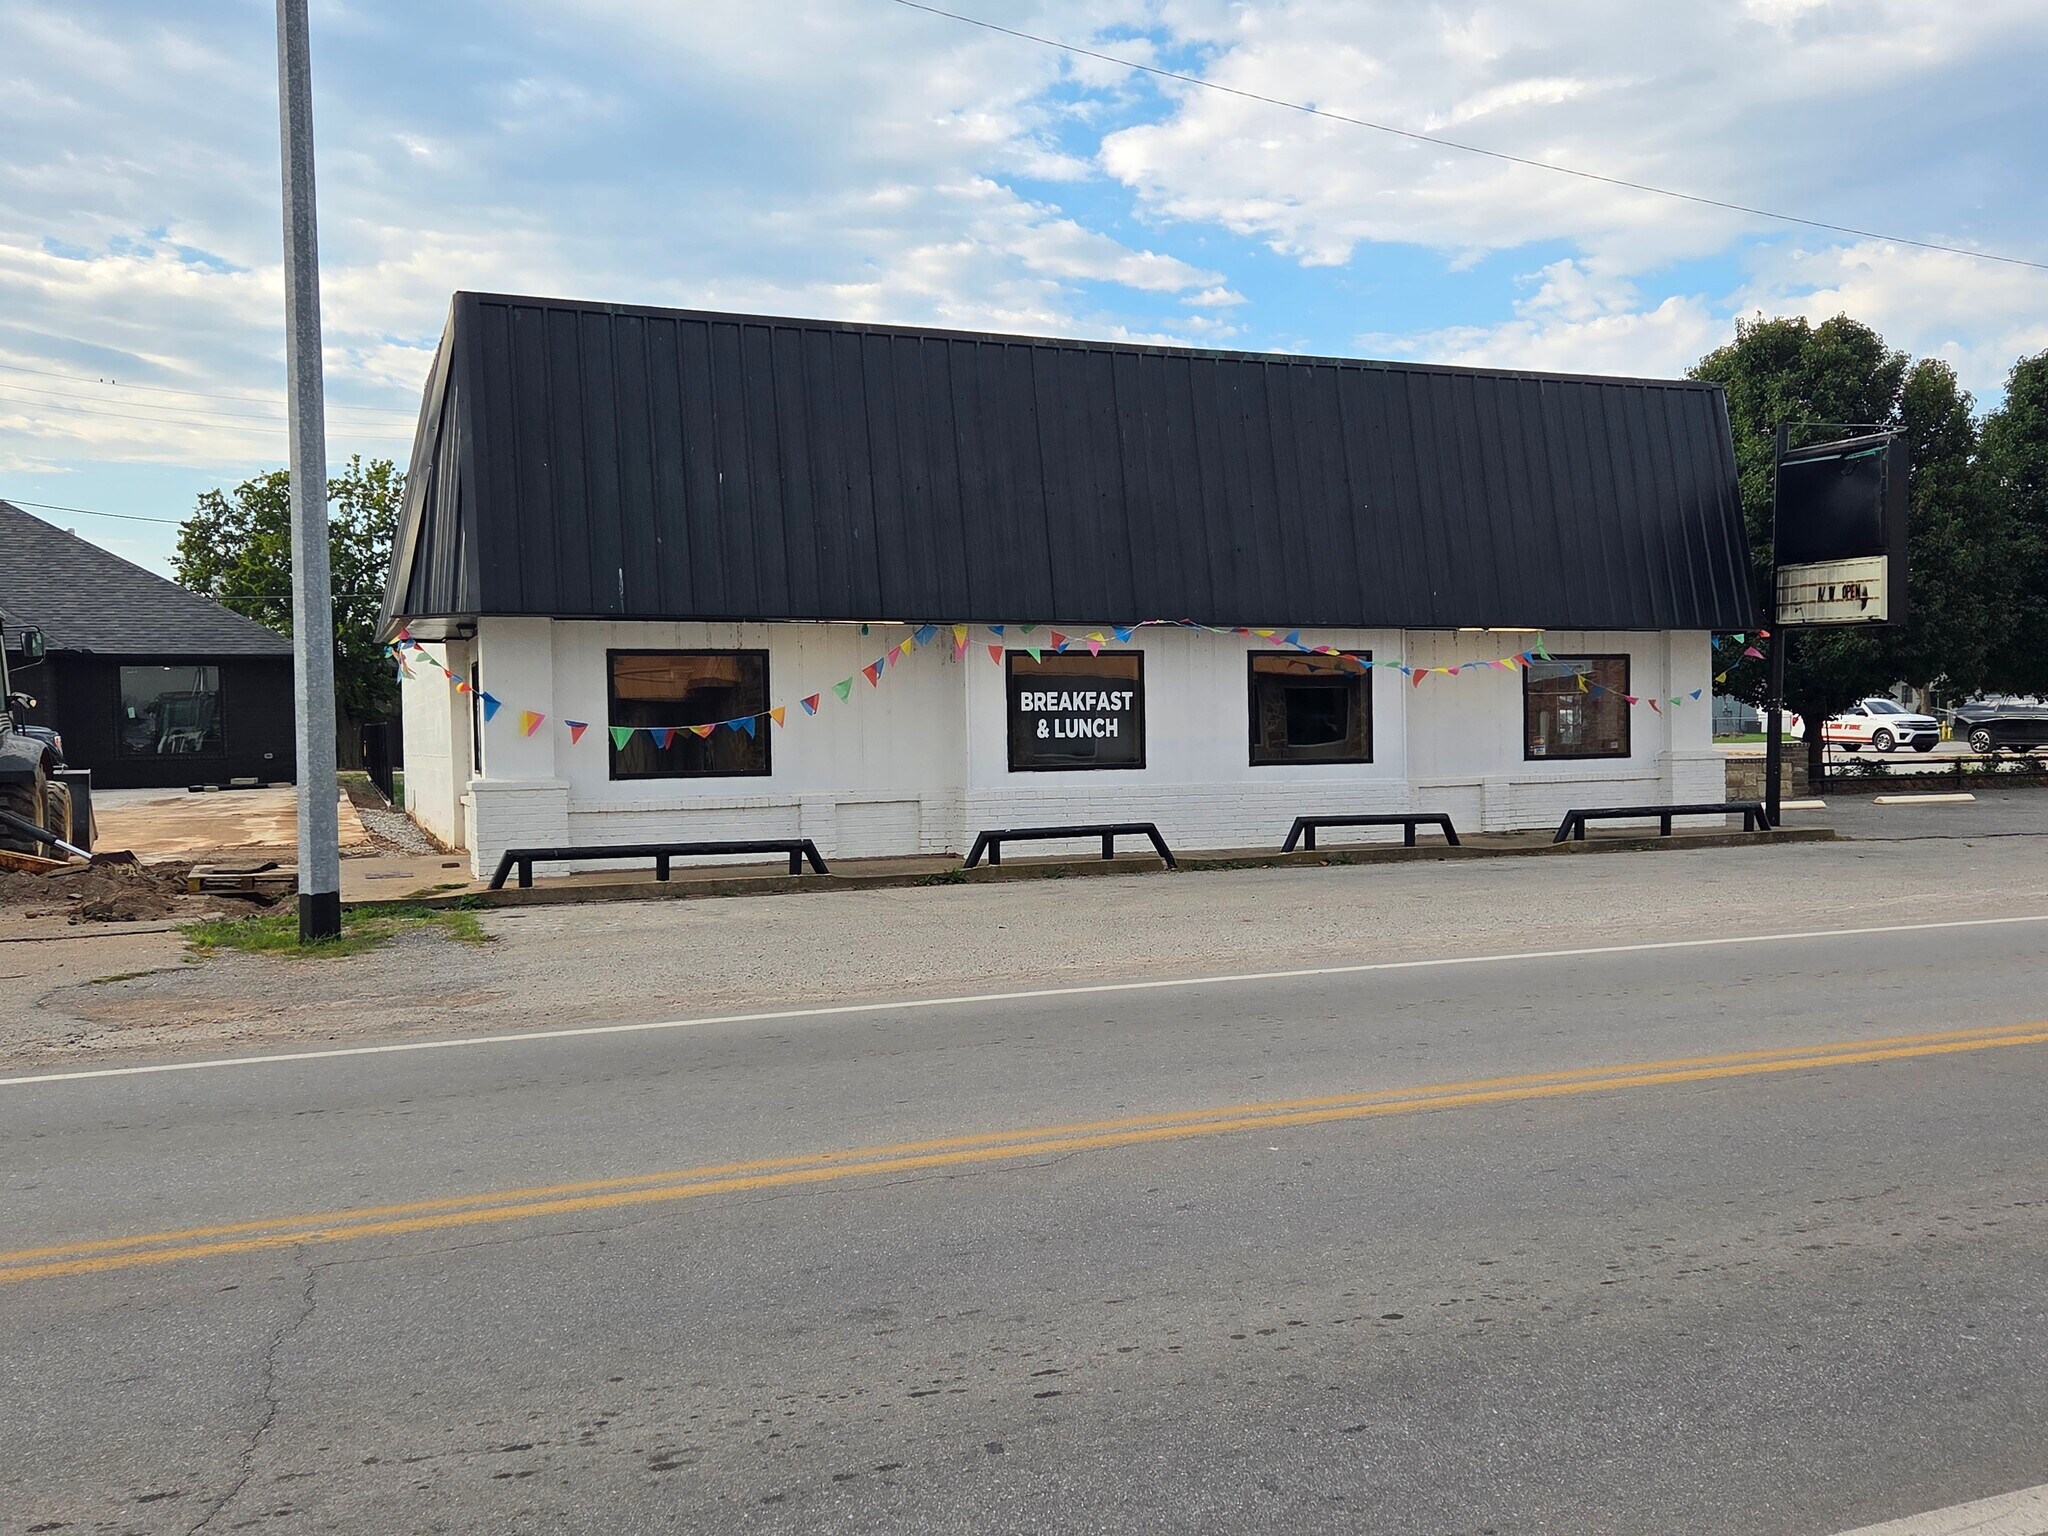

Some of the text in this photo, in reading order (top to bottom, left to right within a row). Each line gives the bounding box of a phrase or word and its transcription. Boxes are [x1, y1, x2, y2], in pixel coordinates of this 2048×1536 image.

[1021, 691, 1133, 711] BREAKFAST
[1036, 718, 1118, 739] & LUNCH
